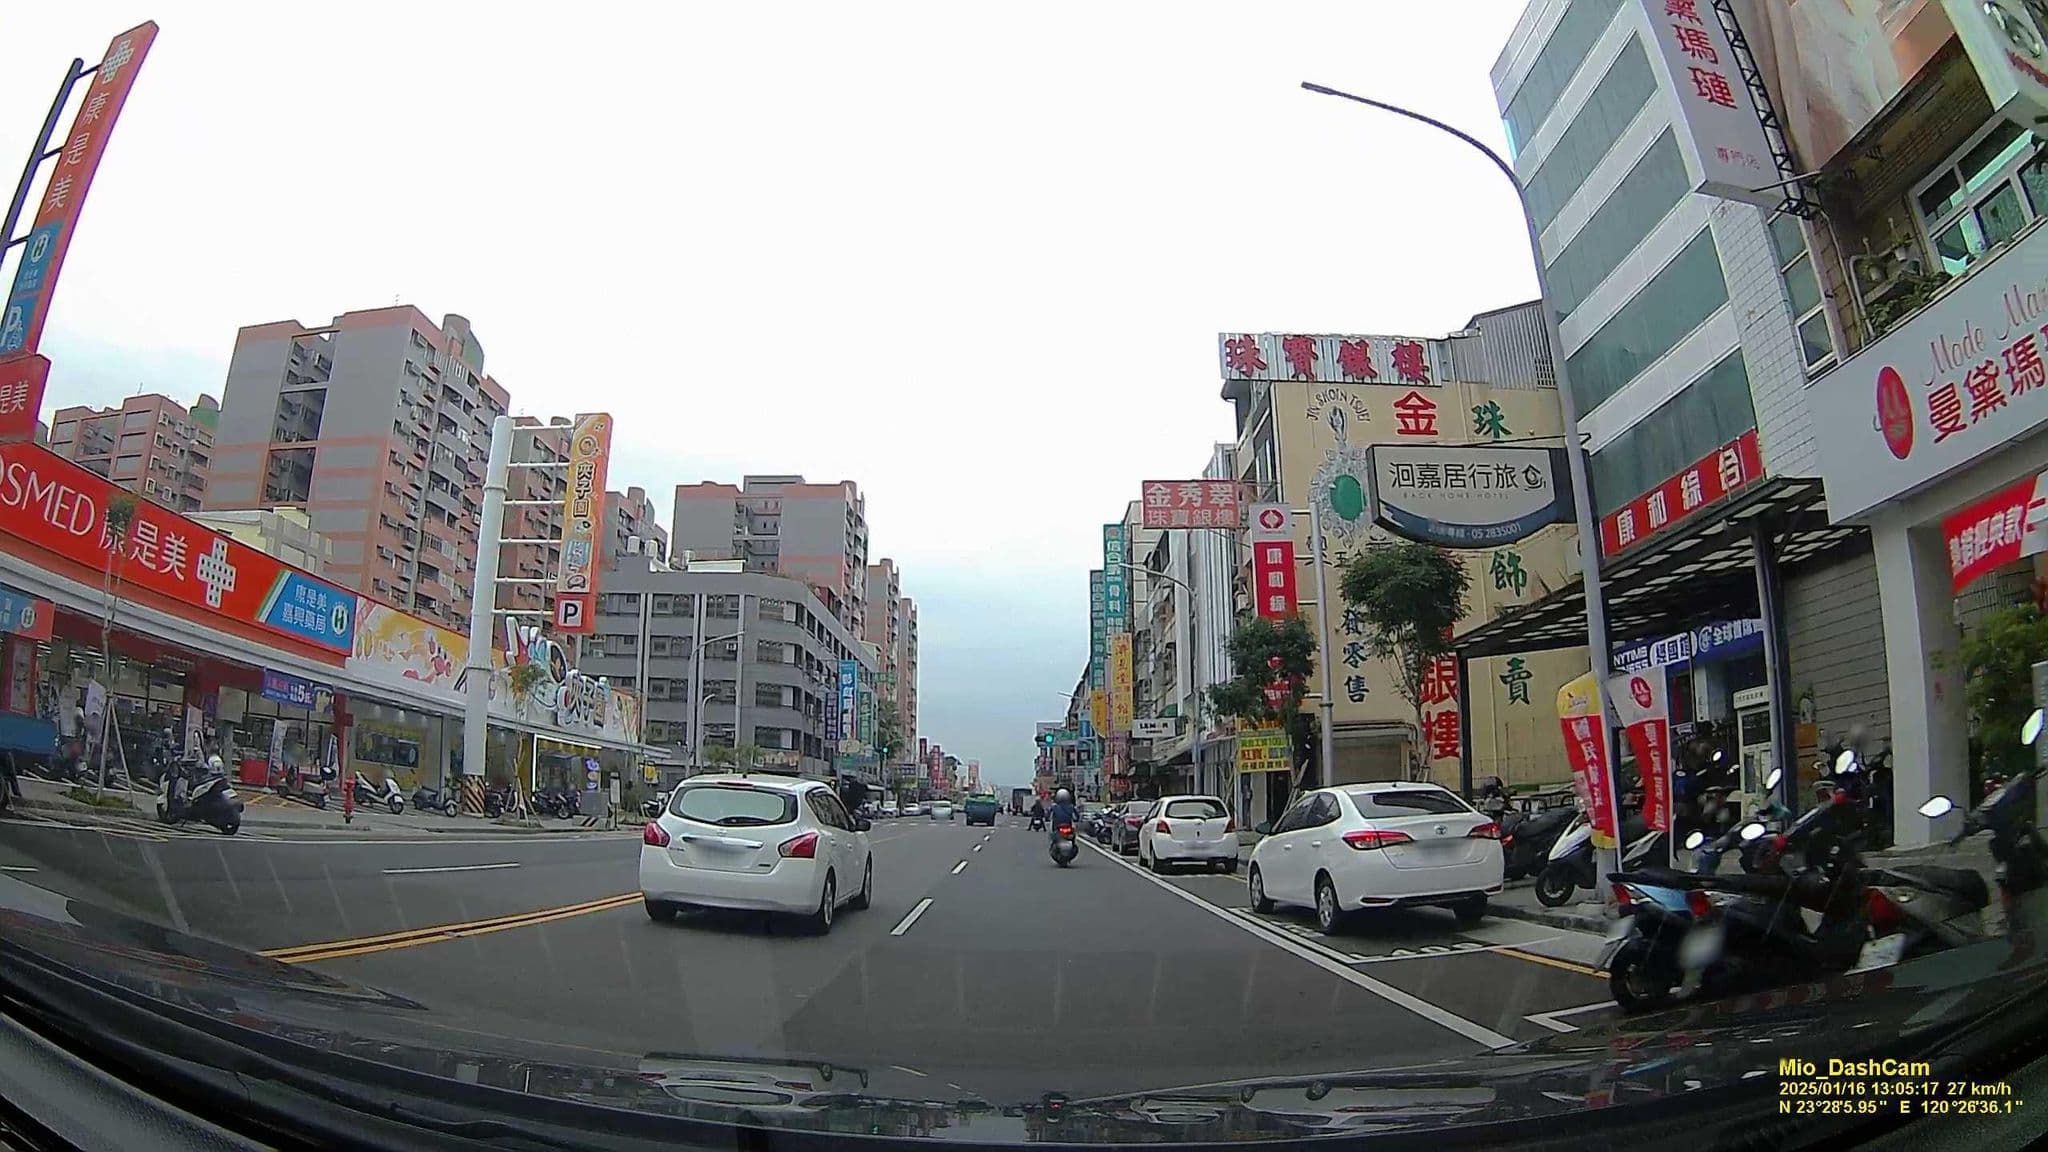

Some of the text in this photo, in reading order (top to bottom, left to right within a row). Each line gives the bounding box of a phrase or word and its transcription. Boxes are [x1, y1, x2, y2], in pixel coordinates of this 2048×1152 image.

[45, 91, 110, 214] 康是美
[1224, 333, 1430, 385] 珠寶銀樓
[1928, 322, 2048, 445] 曼黛瑪
[1392, 390, 1439, 436] 金
[0, 450, 95, 536] SMED
